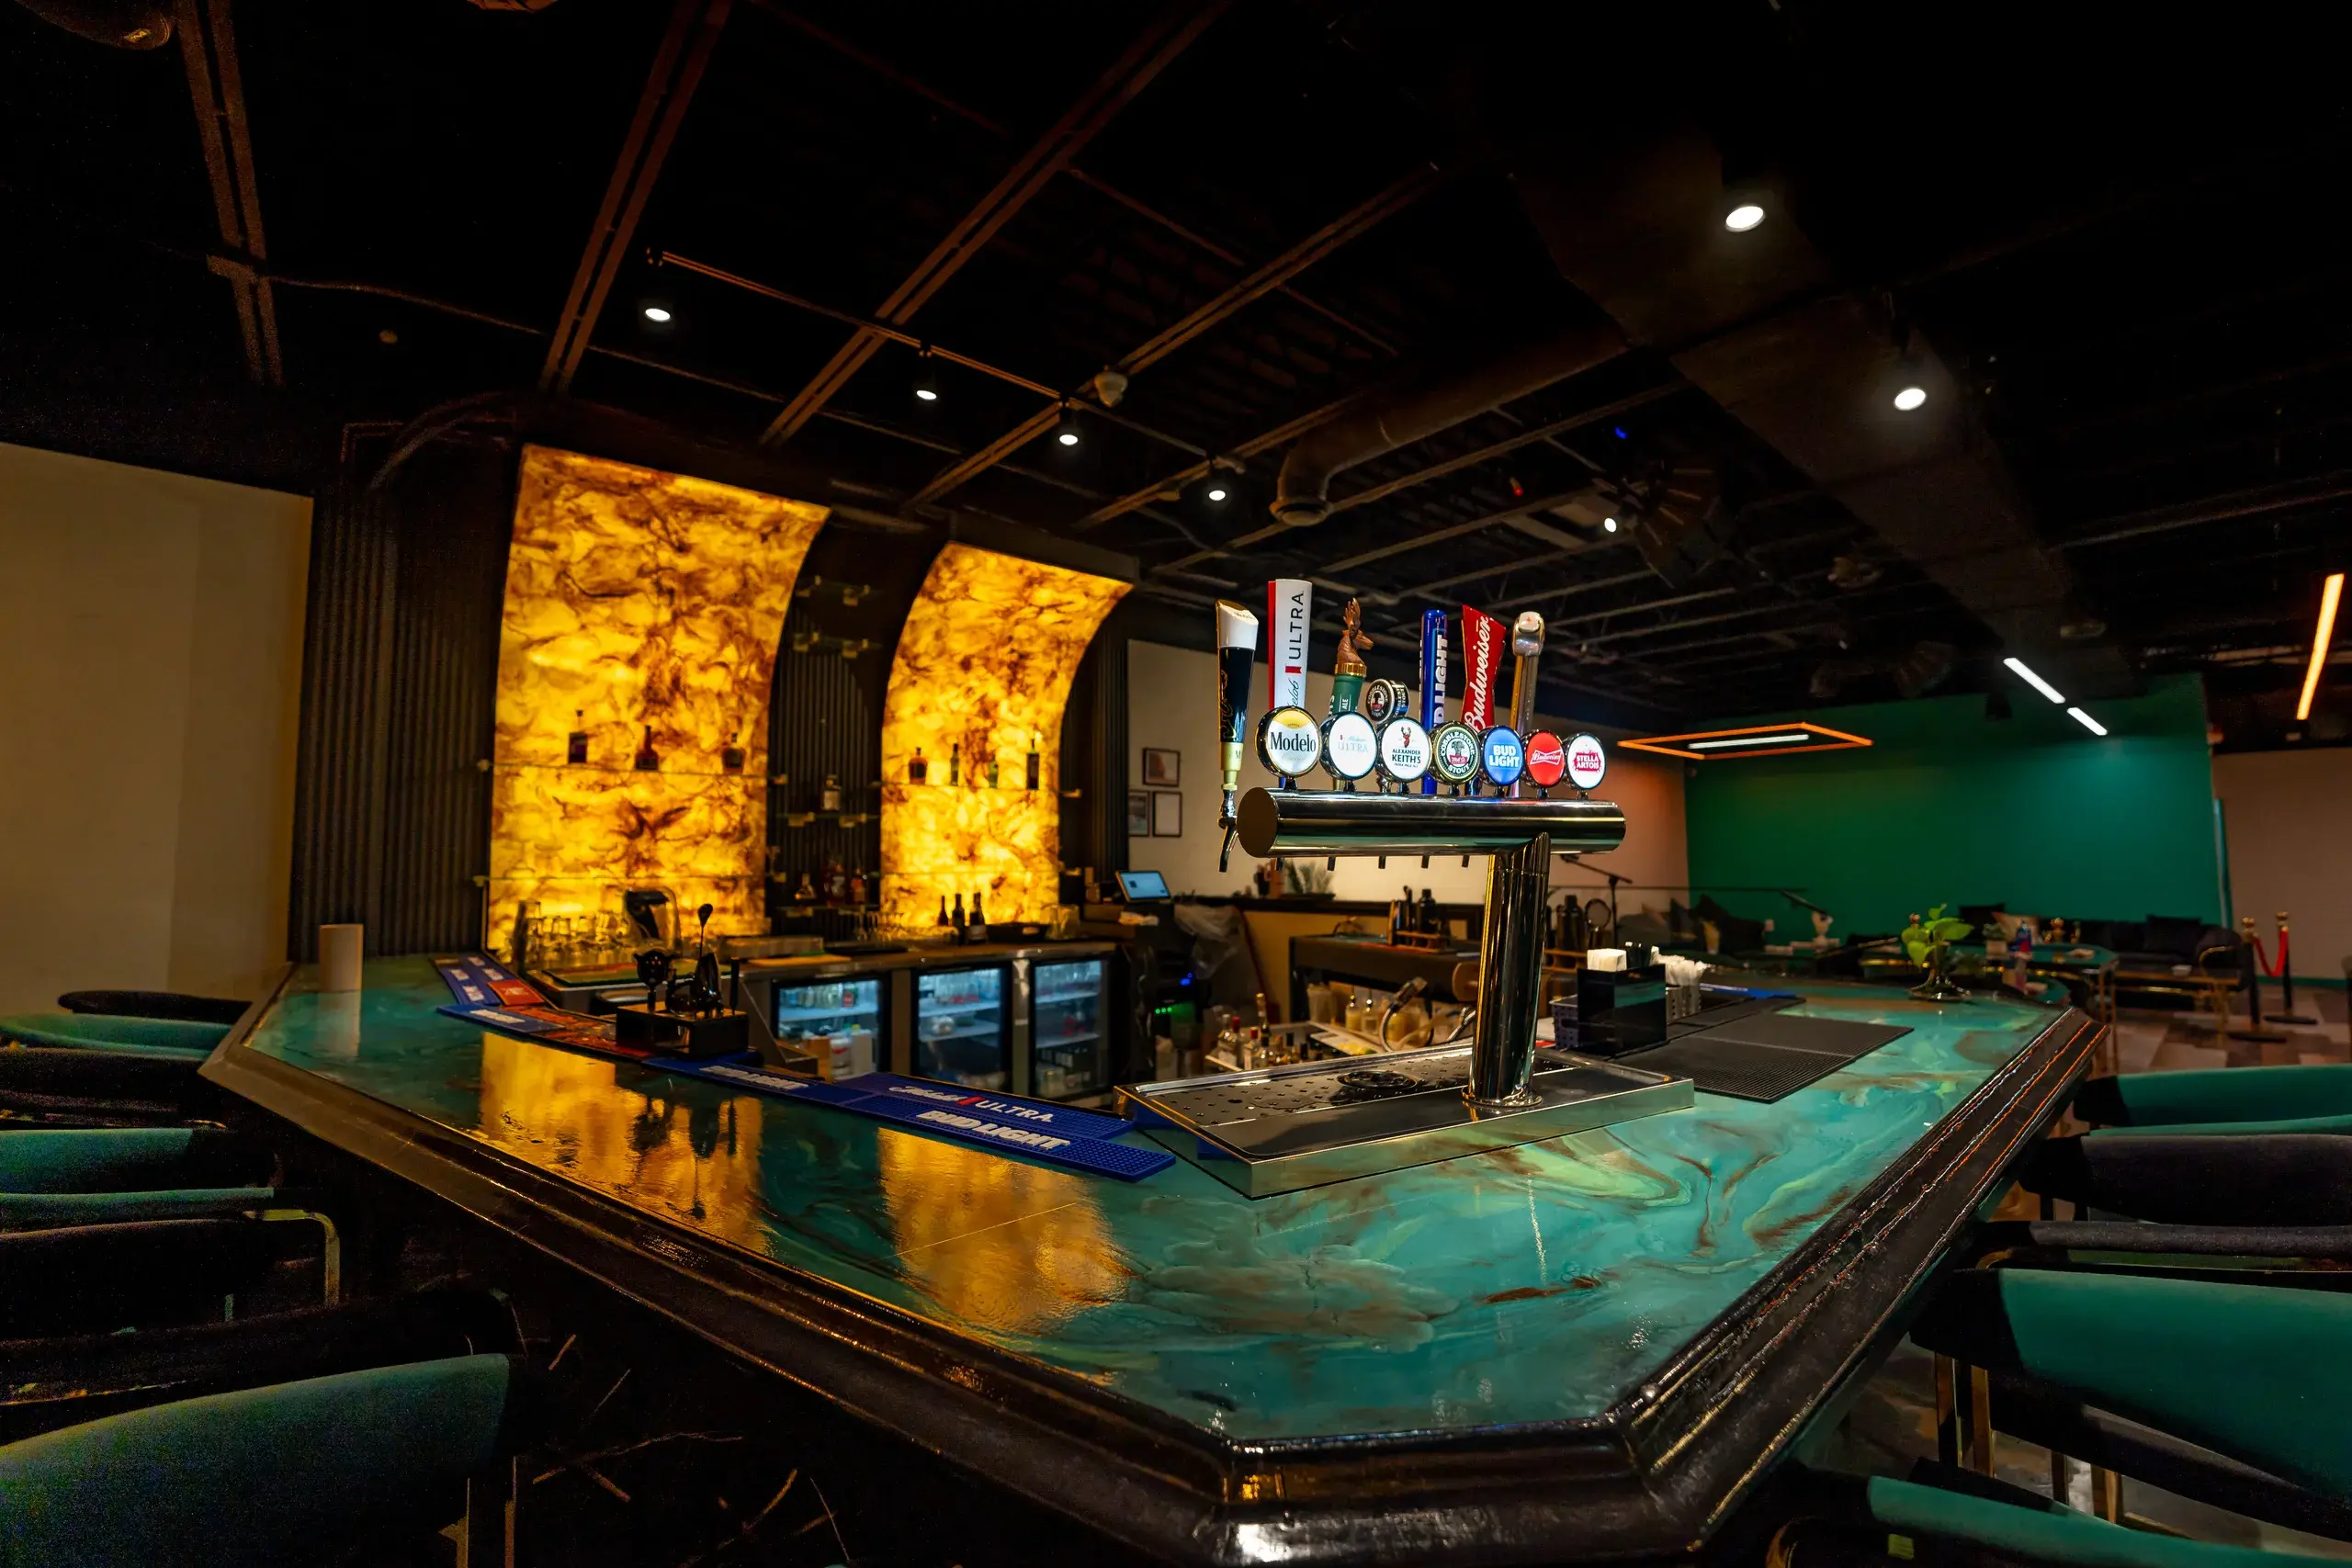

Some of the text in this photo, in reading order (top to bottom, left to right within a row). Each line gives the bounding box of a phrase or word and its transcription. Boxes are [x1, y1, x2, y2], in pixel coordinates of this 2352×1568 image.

[1288, 592, 1304, 660] ULTRA
[1435, 634, 1448, 705] LIGHT
[1464, 615, 1490, 732] Budweiser
[1271, 731, 1317, 752] Modelo
[1441, 732, 1476, 756] COBBLESTONE
[1493, 745, 1517, 757] BUD
[1392, 754, 1421, 763] KEITH'S
[1448, 764, 1470, 774] STOUT
[1489, 755, 1521, 768] LIGHT
[1576, 761, 1600, 770] ARTOIS
[975, 1100, 1055, 1122] ULTRA
[916, 1110, 1071, 1151] BUD LIGHT
